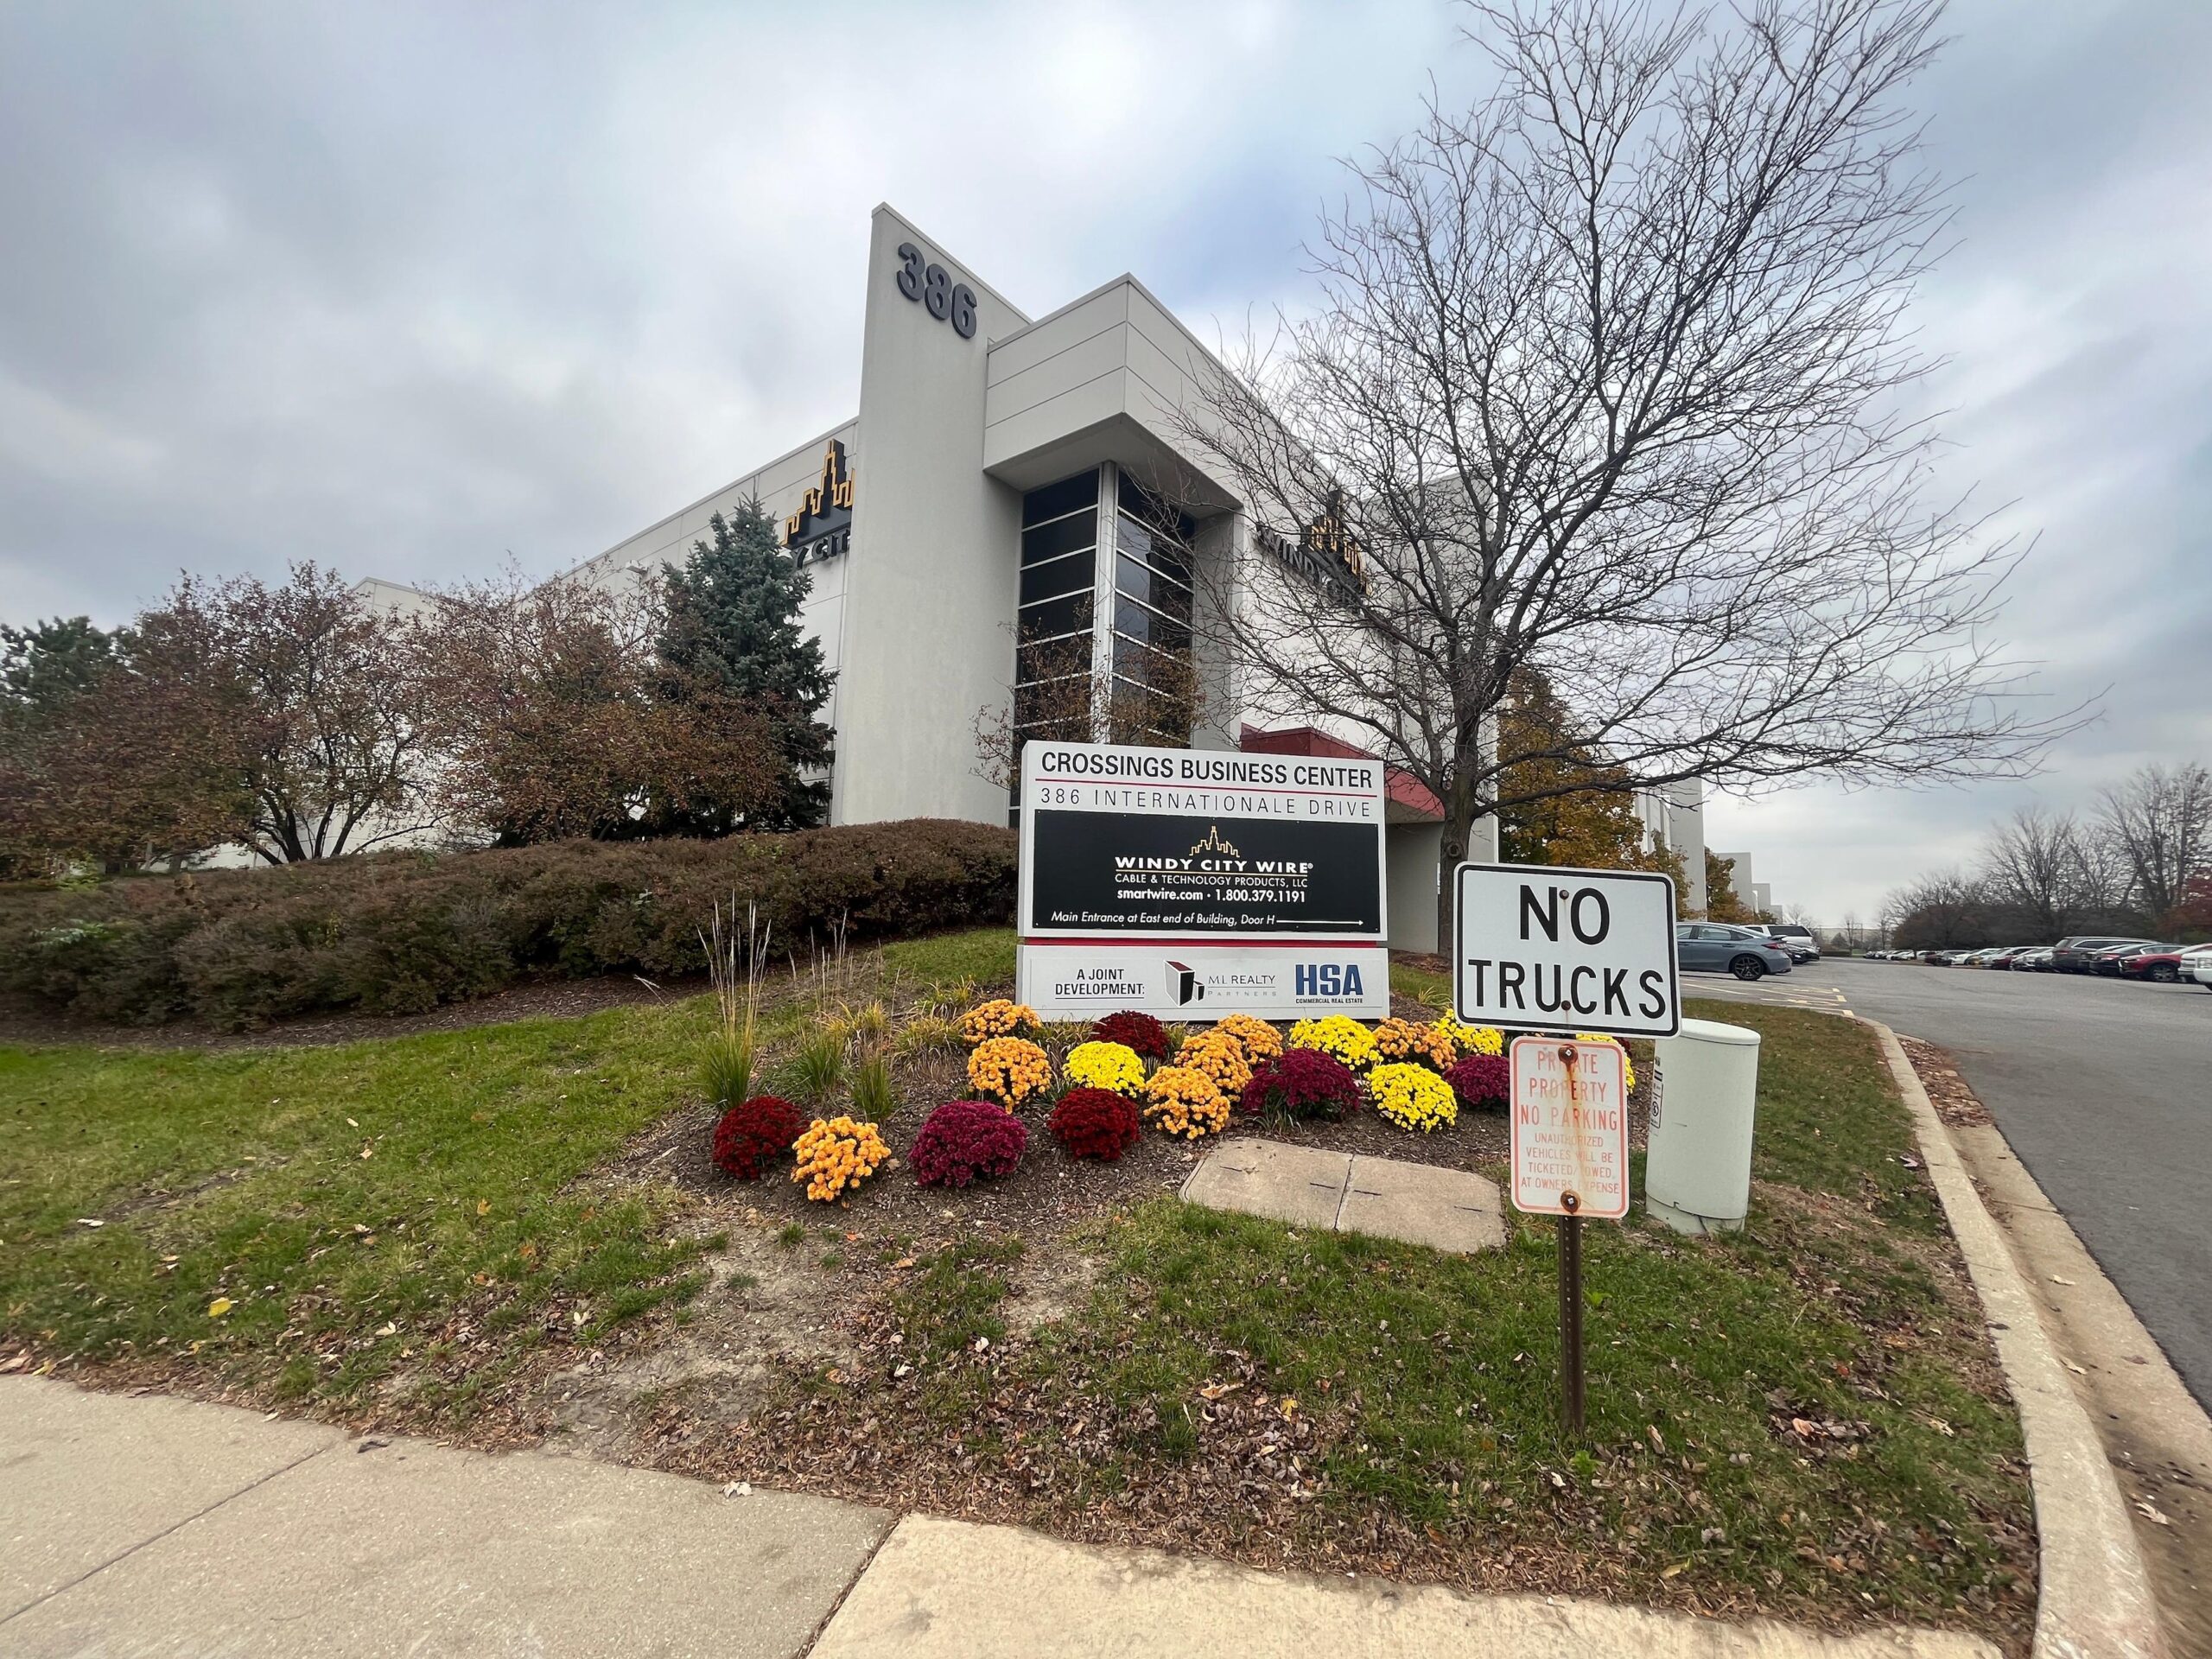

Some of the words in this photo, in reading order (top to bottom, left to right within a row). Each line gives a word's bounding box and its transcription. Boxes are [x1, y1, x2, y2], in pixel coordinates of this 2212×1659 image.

[897, 242, 977, 339] 386
[1041, 752, 1173, 779] CROSSINGS
[1181, 760, 1287, 785] BUSINESS
[1294, 766, 1372, 788] CENTER
[1040, 787, 1080, 804] 386
[1095, 790, 1295, 814] INTERNATIONALE
[1309, 799, 1370, 817] DRIVE
[1115, 856, 1193, 870] WINDY
[1200, 859, 1248, 872] CITY
[1115, 874, 1147, 883] CABLE
[1150, 874, 1158, 884] &
[1161, 874, 1231, 886] TECHNOLOGY
[1235, 877, 1289, 888] PRODUCTS,
[1293, 878, 1308, 887] LLC
[1117, 887, 1204, 900] smartwire.com
[1216, 889, 1306, 903] 1.800.379.1191
[1051, 911, 1078, 922] Main
[1081, 912, 1125, 923] Entrance
[1127, 914, 1138, 923] at
[1140, 912, 1160, 924] East
[1162, 912, 1182, 924] end
[1184, 912, 1195, 924] of
[1196, 912, 1237, 927] Building,
[1241, 914, 1264, 925] Door
[1266, 914, 1275, 925] H
[1519, 884, 1611, 945] NO
[1077, 969, 1085, 980] A
[1088, 969, 1125, 981] JOINT
[1230, 975, 1275, 984] REALTY
[1295, 964, 1363, 995] HSA
[1055, 983, 1145, 995] DEVELOPMENT:
[1467, 959, 1667, 1020] TRUCKS
[1537, 1050, 1599, 1074] PRATE
[1529, 1077, 1607, 1103] PROPERTY
[1521, 1104, 1540, 1126] NO
[1551, 1106, 1618, 1131] PARKING
[1535, 1133, 1604, 1147] UNAUTHORIZED
[1526, 1147, 1571, 1160] VEHICLES
[1575, 1151, 1597, 1163] WILL
[1601, 1152, 1613, 1163] BE
[1521, 1177, 1532, 1188] AT
[1535, 1178, 1573, 1191] OWNERS
